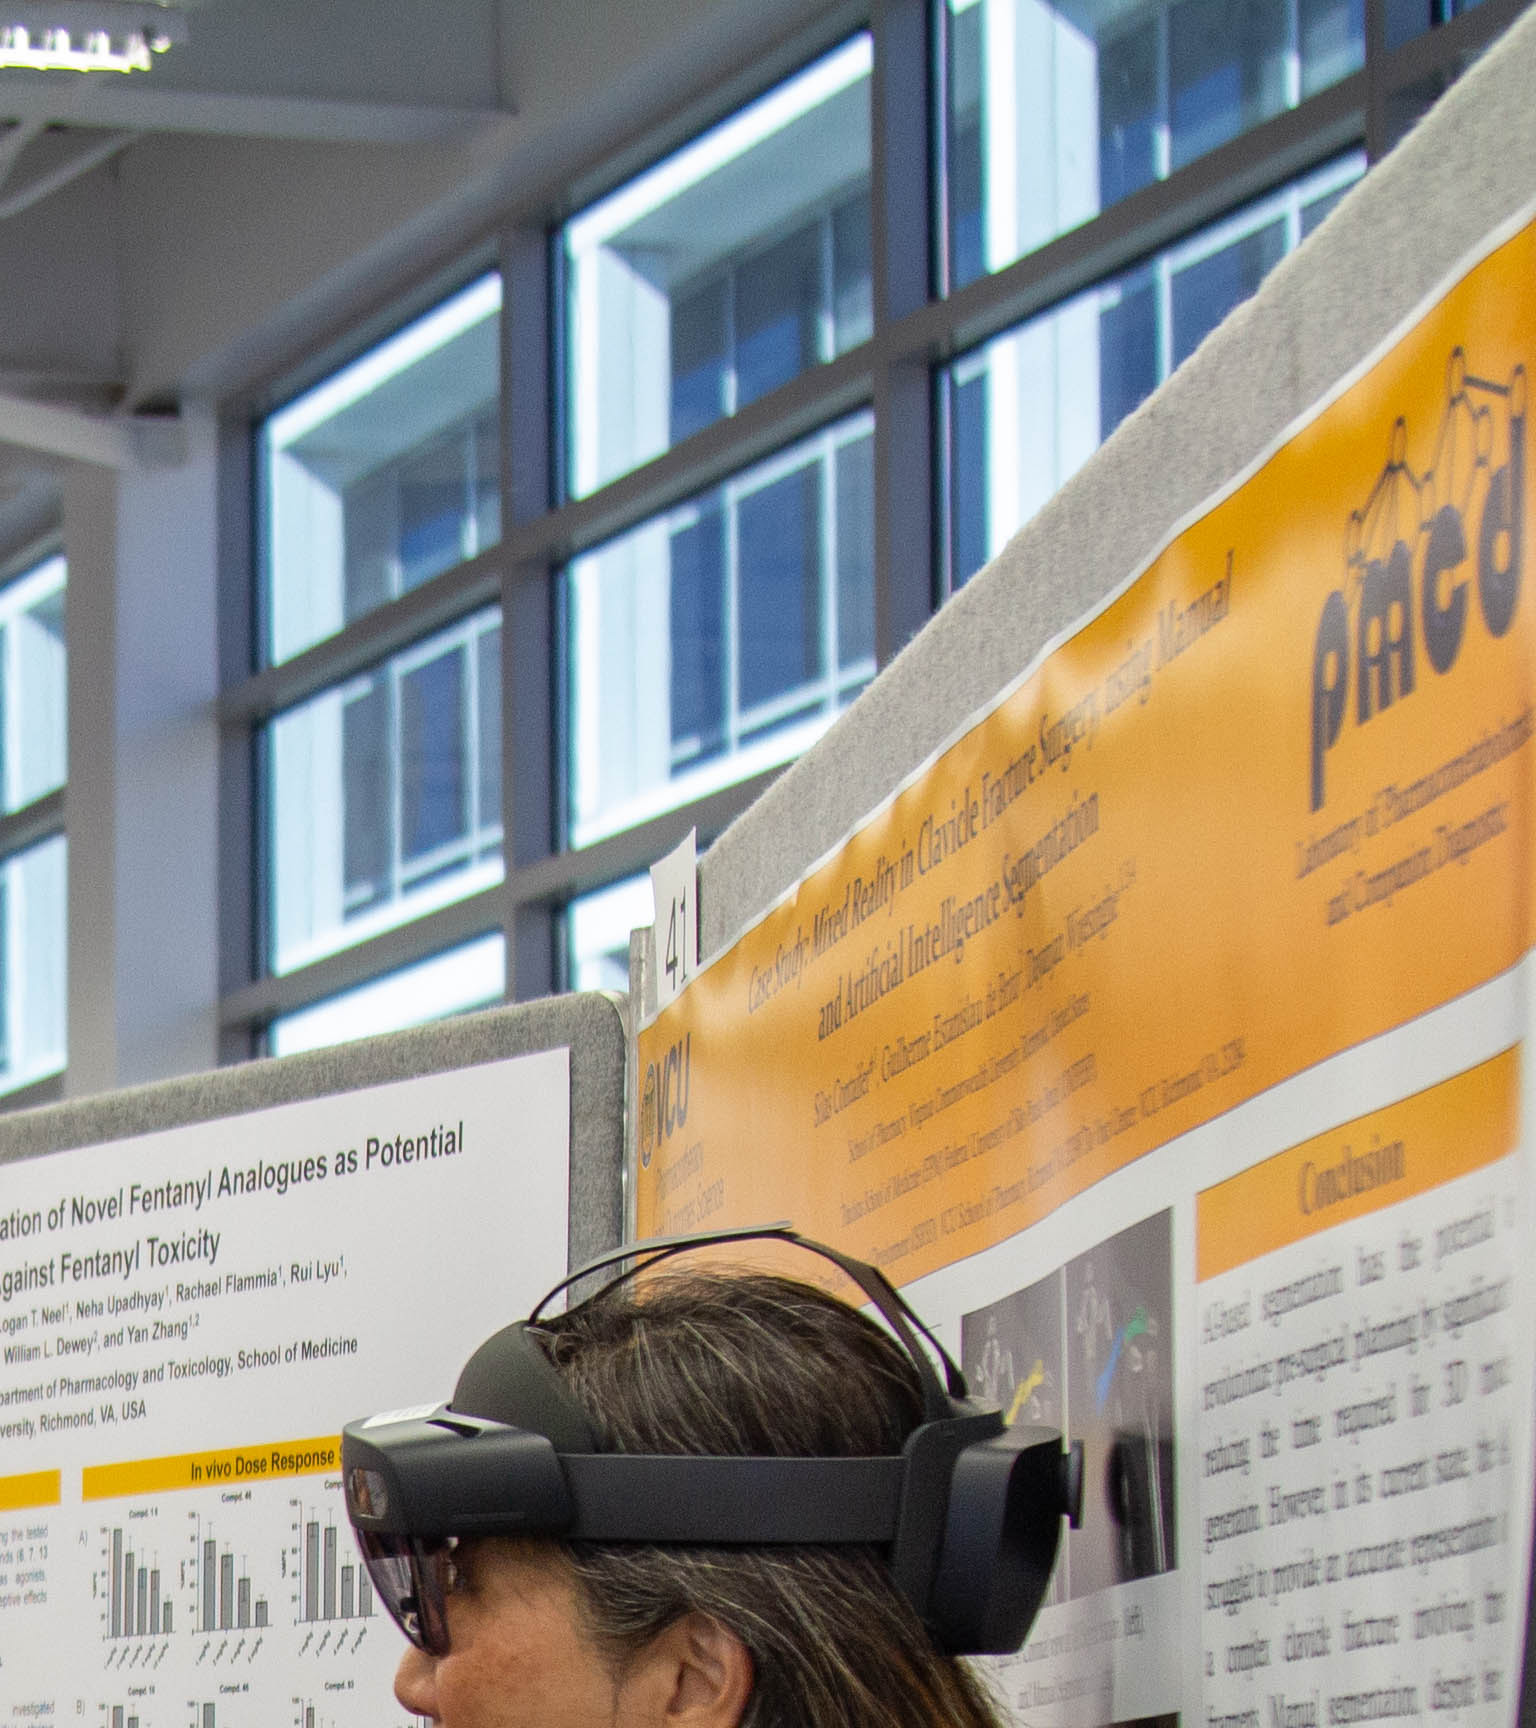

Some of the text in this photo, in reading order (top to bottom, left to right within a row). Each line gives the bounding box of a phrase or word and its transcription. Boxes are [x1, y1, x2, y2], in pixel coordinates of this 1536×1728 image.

[812, 882, 850, 962] Mixed
[852, 856, 898, 917] Reality
[901, 840, 913, 891] in
[918, 787, 977, 875] Clavicle
[982, 745, 1036, 829] Fracture
[665, 885, 688, 991] 41
[818, 976, 842, 1041] and
[845, 928, 904, 1024] Artificial
[907, 882, 1000, 977] Intelligence
[1002, 791, 1098, 918] Segmentation
[656, 1031, 690, 1147] VCU
[47, 1198, 66, 1231] of
[71, 1187, 123, 1226] Novel
[129, 1169, 212, 1215] Fentanyl
[216, 1155, 327, 1198] Analogues
[334, 1149, 357, 1176] as
[365, 1120, 463, 1170] Potential
[1299, 1134, 1406, 1216] Conclusion
[60, 1239, 139, 1283] Fentanyl
[146, 1229, 220, 1267] Toxicity
[76, 1298, 103, 1319] Neha
[175, 1276, 221, 1302] Rachael
[290, 1262, 312, 1283] Rui
[3, 1344, 41, 1365] William
[103, 1326, 124, 1349] and
[126, 1325, 148, 1344] Yan
[46, 1378, 57, 1399] of
[59, 1369, 139, 1396] Pharmacology
[142, 1362, 164, 1384] and
[167, 1355, 233, 1380] Toxicology,
[237, 1344, 280, 1370] School
[284, 1341, 298, 1363] of
[301, 1335, 357, 1360] Medicine
[121, 1399, 146, 1420] USA
[191, 1461, 202, 1481] In
[205, 1458, 231, 1479] vivo
[235, 1455, 267, 1476] Dose
[271, 1449, 334, 1474] Response
